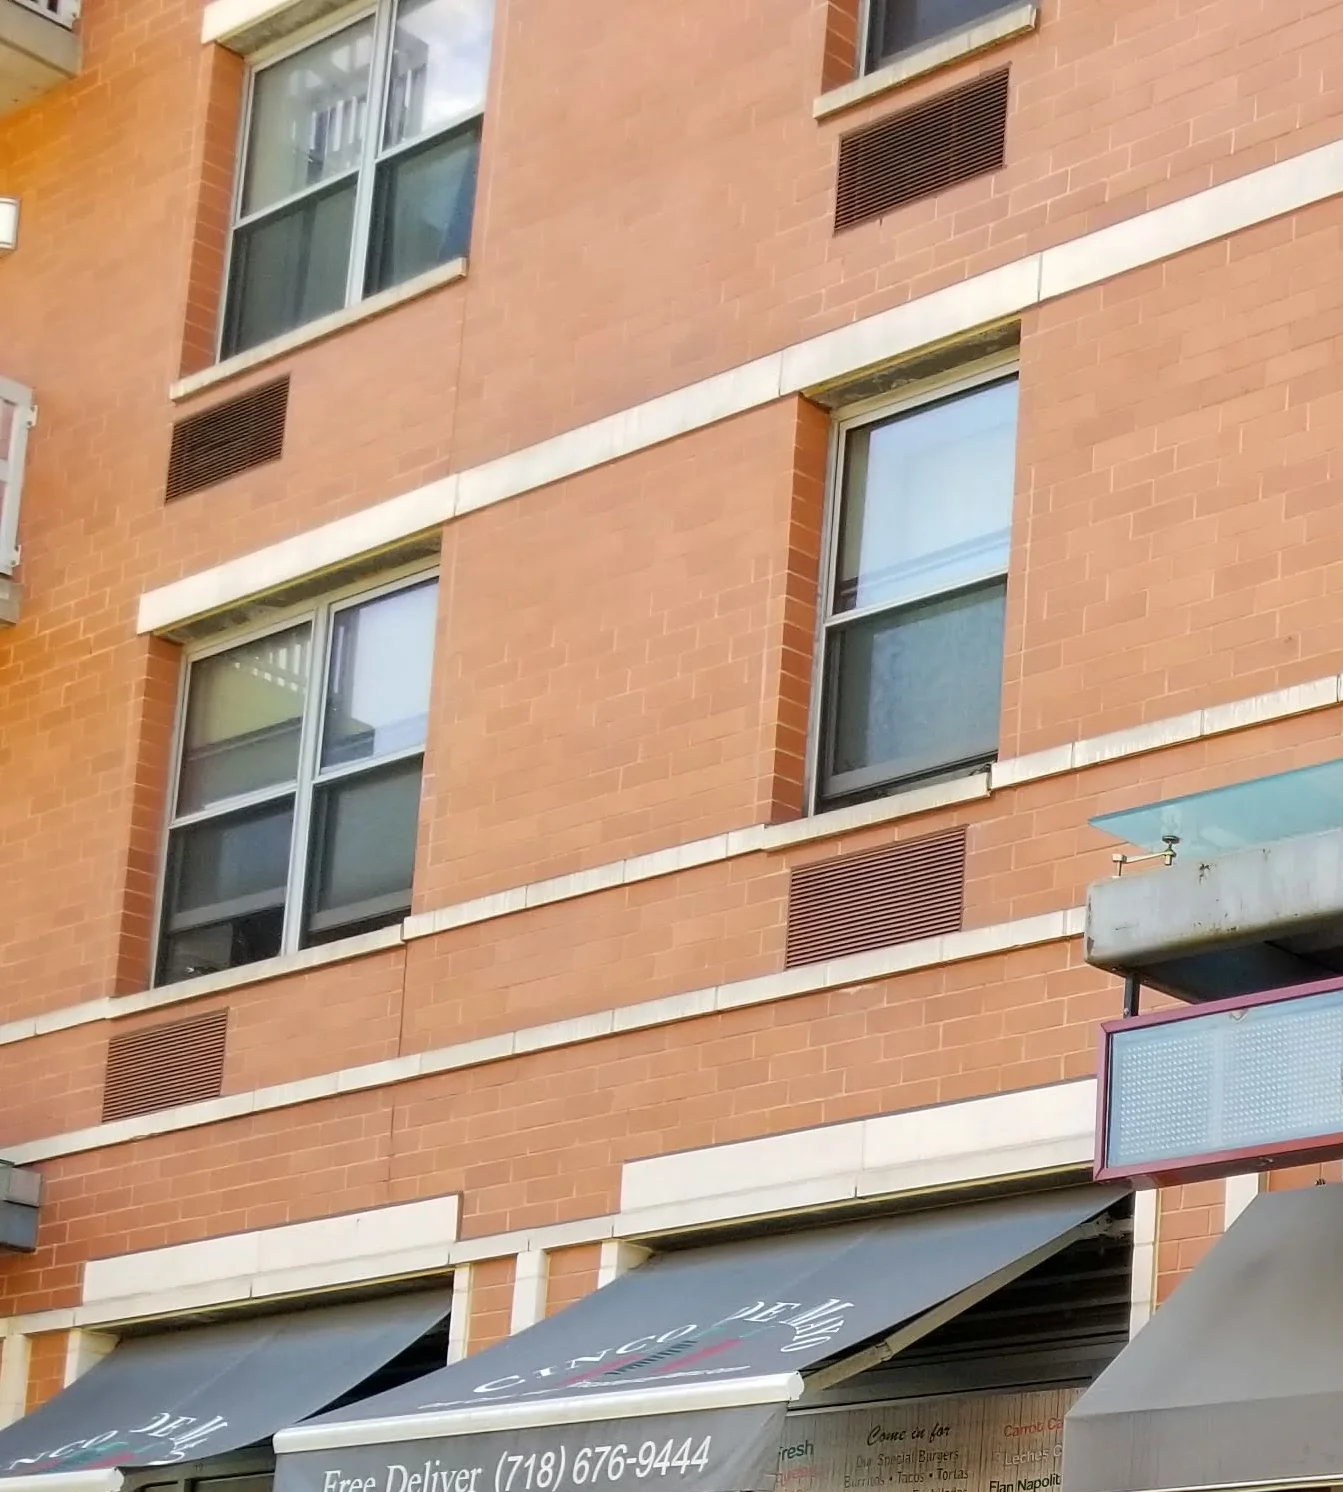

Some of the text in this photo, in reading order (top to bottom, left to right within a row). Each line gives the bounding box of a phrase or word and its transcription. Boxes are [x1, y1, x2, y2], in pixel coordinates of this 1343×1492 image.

[867, 1423, 950, 1446] Come in for
[1004, 1421, 1044, 1437] Carrot
[572, 1435, 712, 1484] 676-9444
[919, 1449, 959, 1463] Burgers
[897, 1471, 924, 1483] Tacos
[936, 1468, 968, 1480] Tortas
[1018, 1473, 1061, 1492] Napolit
